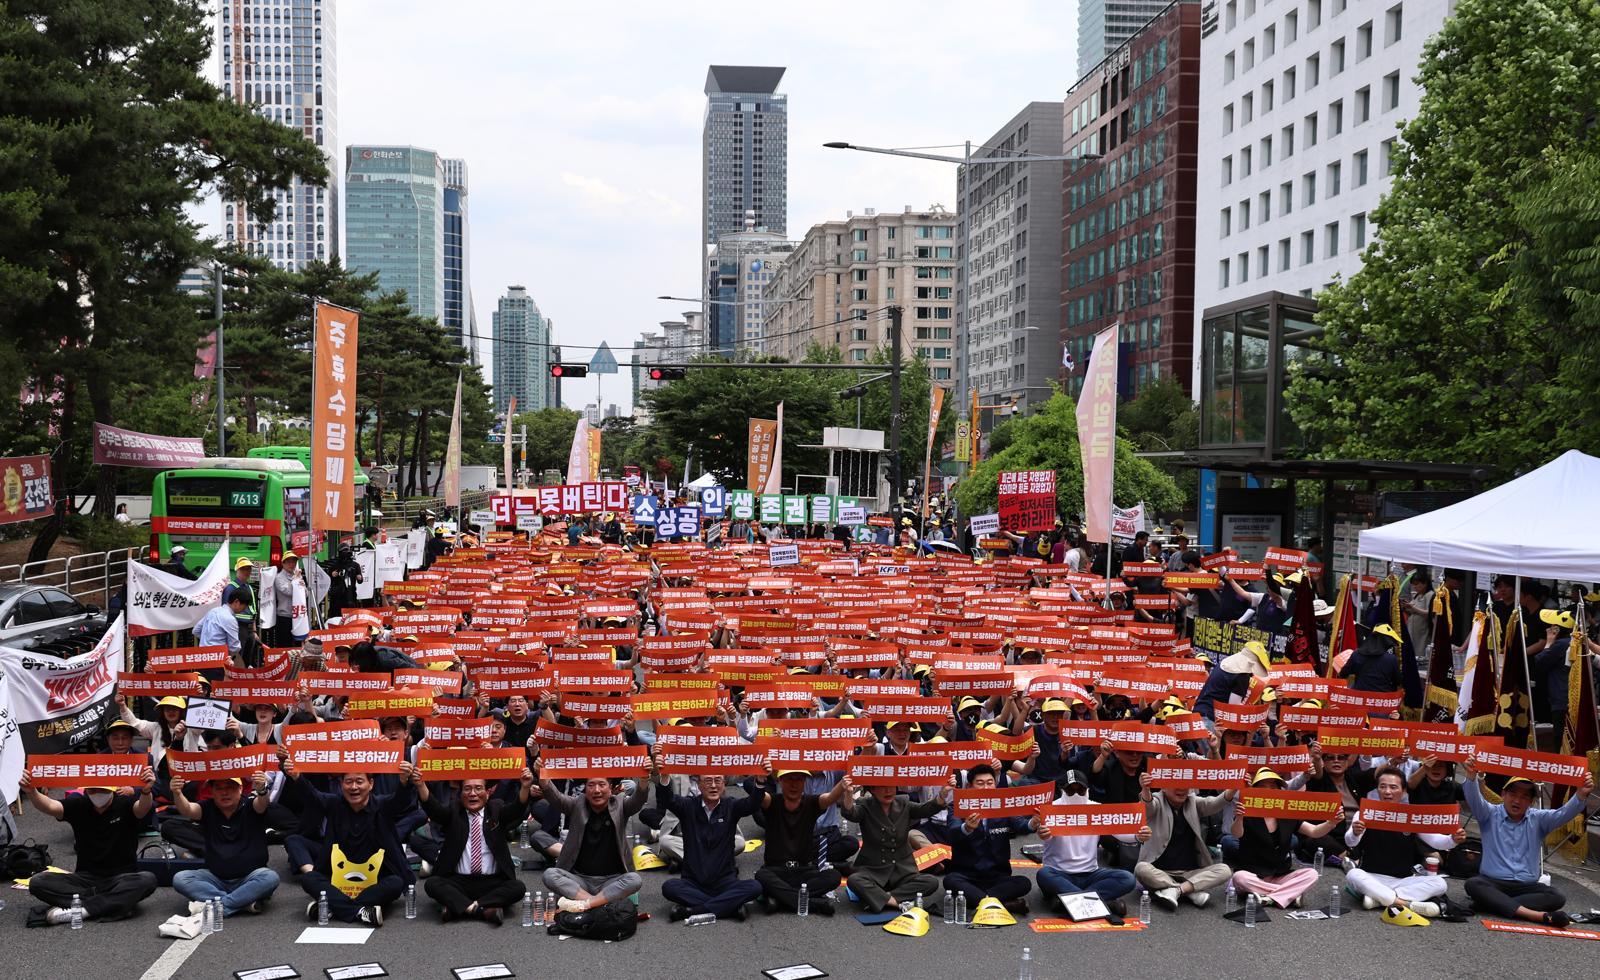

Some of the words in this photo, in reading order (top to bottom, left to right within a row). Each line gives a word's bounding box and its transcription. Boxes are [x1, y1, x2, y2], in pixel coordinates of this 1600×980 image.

[374, 150, 402, 159] 한화손보
[751, 424, 762, 464] 소상공인
[1029, 470, 1054, 482] 자영업자!
[1030, 482, 1055, 494] 자영업자!
[233, 494, 258, 504] 7613
[1019, 496, 1054, 511] 최저시급
[168, 521, 194, 529] 대한민국
[151, 657, 183, 665] 생존권을
[186, 653, 224, 662] 보장하라!!
[641, 657, 664, 665] 생존권을
[837, 655, 863, 663] 생존권을
[866, 653, 897, 661] 보장하라!!
[935, 661, 963, 669] 생존권을
[118, 680, 151, 688] 생존권을
[154, 681, 196, 689] 보장하라!!
[310, 679, 343, 688] 생존권을
[346, 681, 387, 689] 보장하라!!
[396, 675, 417, 683] 생존권을
[422, 677, 458, 686] 보장하라!!
[480, 681, 508, 689] 생존권을
[512, 679, 551, 688] 보장하라!!
[648, 680, 678, 688] 고용정책
[681, 680, 717, 688] 전환하라!!
[973, 681, 1012, 689] 보장하라!!
[1100, 678, 1127, 688] 생존권을
[1132, 682, 1167, 692] 보장하라!!
[849, 686, 878, 694] 생존권을
[1031, 682, 1060, 691] 생존권을
[1282, 683, 1312, 692] 생존권을
[215, 688, 249, 696] 생존권을
[252, 688, 293, 696] 보장하라!!
[747, 692, 774, 701] 생존권을
[778, 692, 812, 700] 보장하라!!
[349, 700, 386, 710] 고용정책
[389, 697, 433, 708] 전환하라!!
[1331, 694, 1363, 703] 생존권을
[565, 702, 597, 711] 생존권을
[634, 702, 669, 711] 고용정책
[672, 700, 714, 709] 전환하라!!
[868, 705, 902, 714] 생존권을
[906, 706, 947, 714] 보장하라!!
[196, 718, 216, 727] 사망
[1283, 714, 1318, 723] 생존권을
[1322, 717, 1363, 725] 보장하라!!
[331, 729, 379, 740] 보장하라!!
[536, 728, 573, 741] 생존권을
[577, 733, 622, 744] 보장하라!!
[780, 729, 818, 738] 생존권을
[822, 728, 867, 738] 보장하라!!
[1063, 728, 1096, 737] 생존권을
[1111, 732, 1144, 742] 생존권을
[658, 735, 696, 745] 생존권을
[1321, 736, 1359, 746] 고용정책
[1362, 738, 1405, 747] 전환하라!!
[1416, 741, 1455, 753] 생존권을
[295, 751, 339, 762] 생존권을
[344, 751, 398, 762] 보장하라!!
[804, 750, 853, 761] 보장하라!!
[949, 750, 992, 760] 보장하라!!
[1270, 754, 1310, 764] 보장하라!!
[210, 752, 263, 770] 보장하라!!
[421, 760, 465, 770] 고용정책
[469, 758, 522, 769] 전환하라!!
[544, 758, 587, 769] 생존권을
[592, 756, 644, 767] 보장하라!!
[664, 754, 707, 765] 생존권을
[711, 755, 763, 768] 보장하라!!
[1477, 753, 1522, 767] 생존권을
[1527, 762, 1584, 776] 보장하라!!
[32, 765, 80, 777] 생존권을
[84, 765, 142, 776] 보장하라!!
[852, 766, 894, 776] 생존권을
[898, 766, 948, 776] 보장하라!!
[1151, 769, 1193, 779] 생존권을
[1197, 769, 1245, 780] 보장하라!!
[959, 799, 1001, 809] 생존권을
[1005, 794, 1052, 807] 보장하라!!
[1244, 797, 1285, 808] 고용정책
[1288, 800, 1337, 811] 전환하라!!
[1045, 815, 1087, 826] 생존권을
[1092, 814, 1142, 825] 보장하라!!
[1363, 810, 1407, 823] 생존권을
[1412, 815, 1459, 828] 보장하라!!
